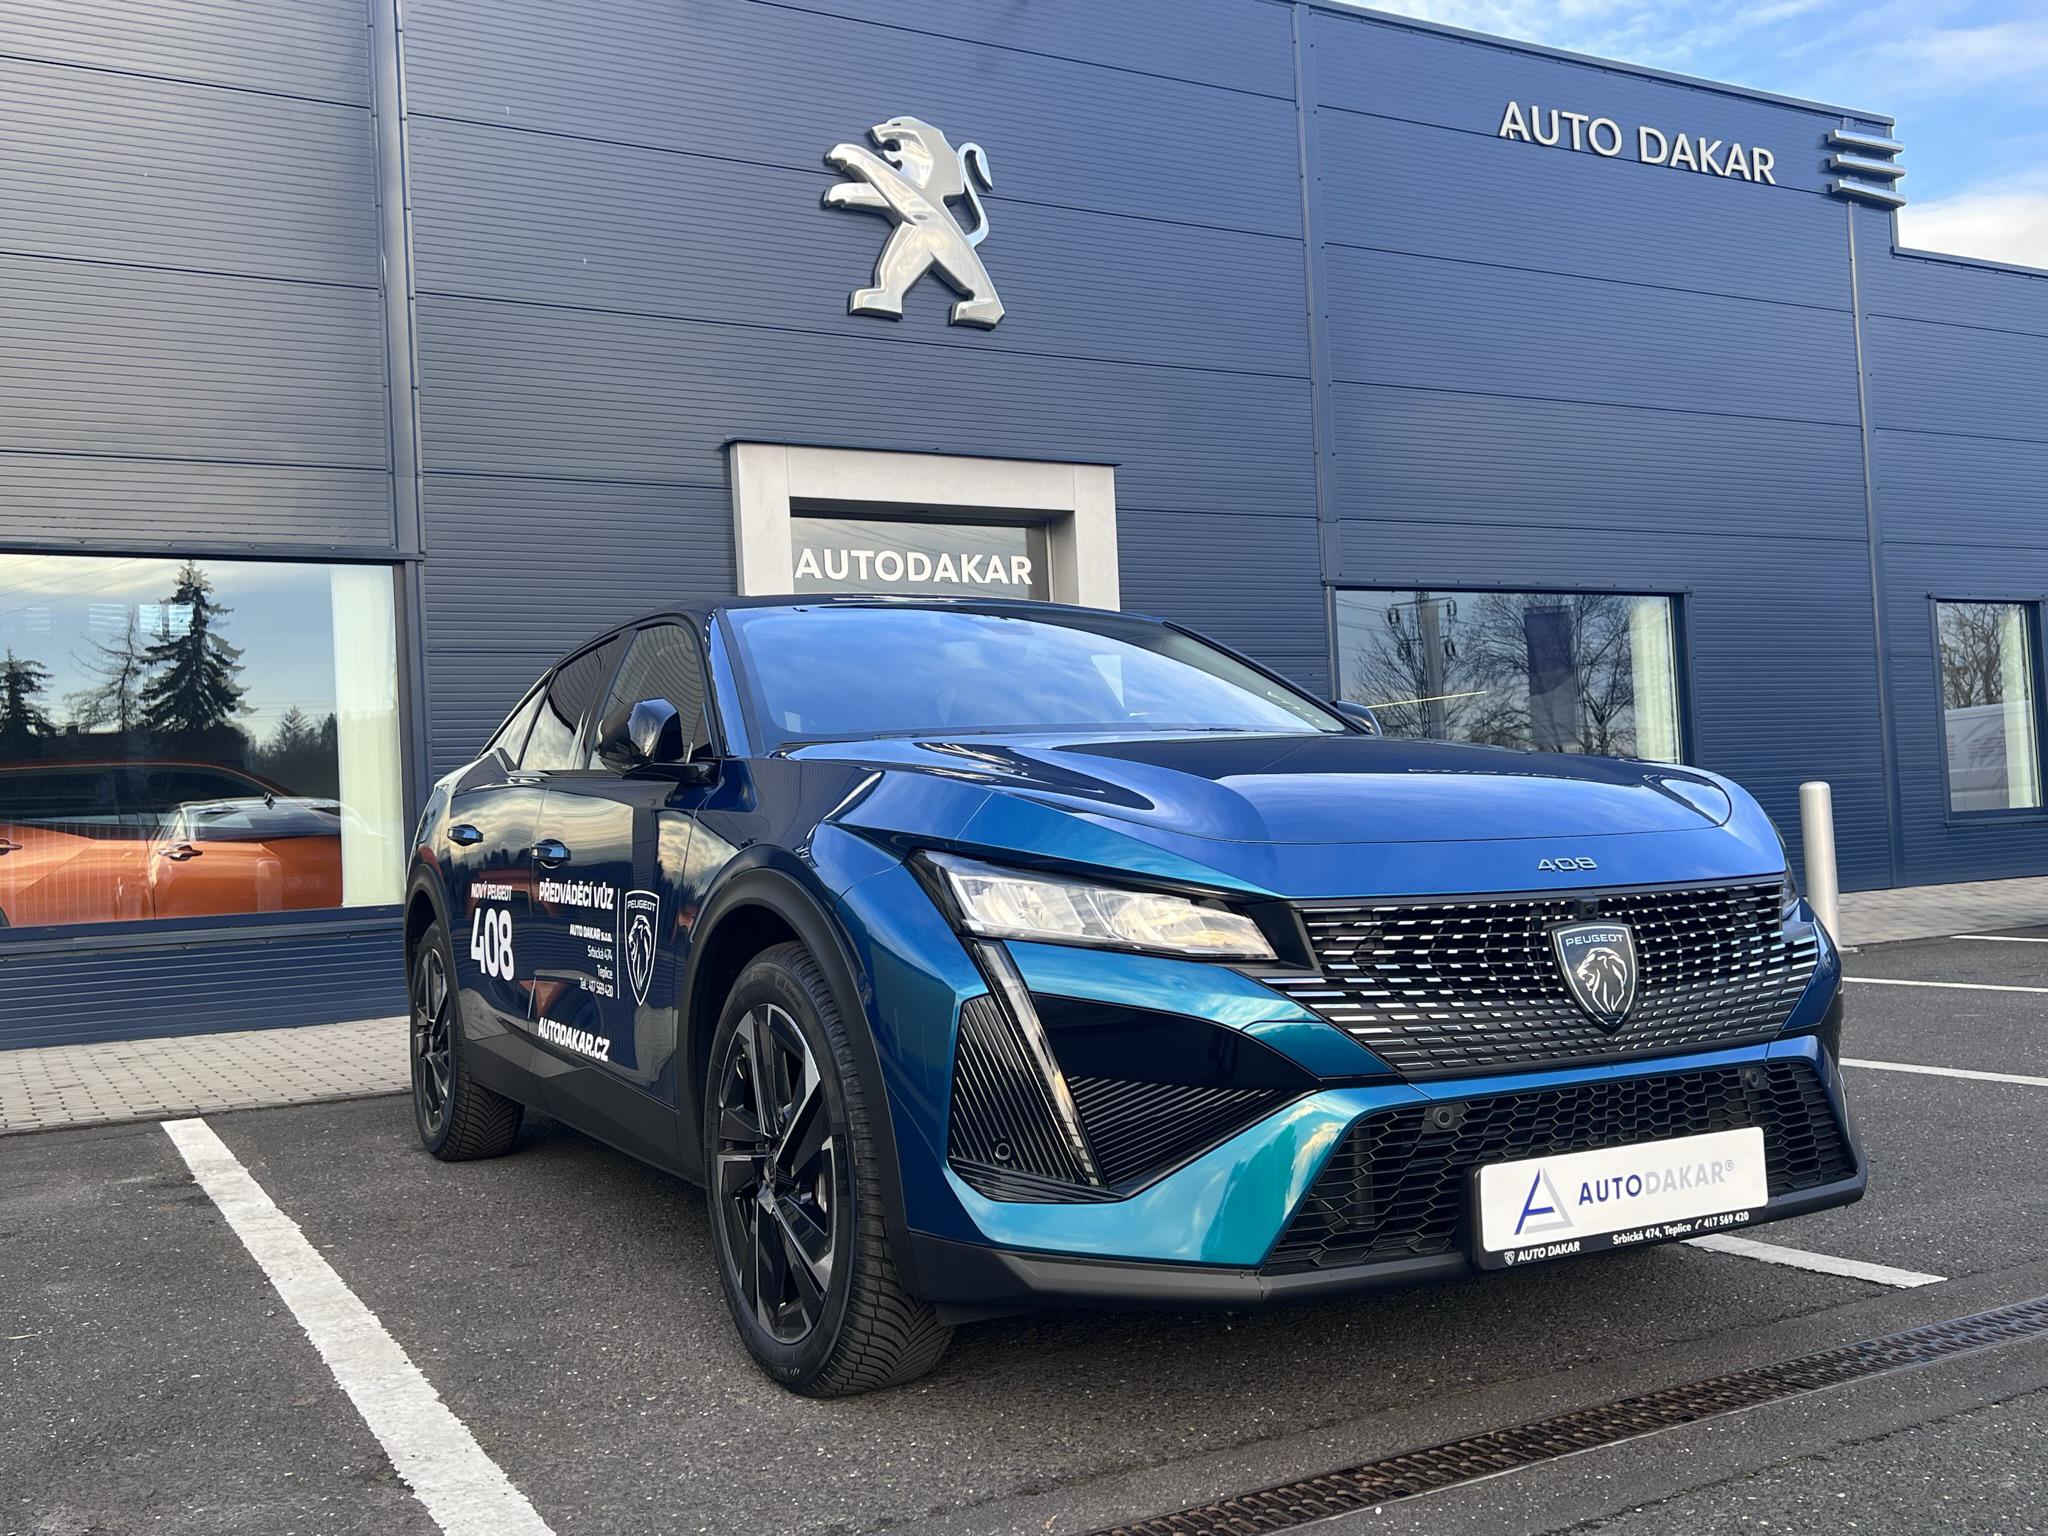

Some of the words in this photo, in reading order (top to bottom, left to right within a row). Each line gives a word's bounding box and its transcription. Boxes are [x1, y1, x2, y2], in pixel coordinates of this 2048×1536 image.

[1499, 101, 1623, 156] AUTO
[1639, 126, 1776, 185] DAKAR
[794, 548, 1033, 585] AUTODAKAR
[1537, 857, 1598, 872] 408
[487, 884, 513, 901] PEUGEOT
[539, 878, 593, 907] PŘEDVÁDĚCÍ
[593, 881, 614, 910] VŮZ
[627, 899, 656, 912] PEUGEOT
[471, 908, 515, 981] 408
[569, 923, 583, 937] AUTO
[583, 926, 601, 940] DAKAR
[1565, 934, 1624, 947] PEUGEOT
[538, 1016, 611, 1062] AUTODAKAR.CZ
[1612, 1230, 1644, 1245] Srbická
[1645, 1227, 1663, 1239] 474,
[1663, 1222, 1692, 1237] Teplice
[1703, 1216, 1718, 1228] 417
[1719, 1214, 1734, 1226] 569
[1734, 1211, 1750, 1222] 420
[1517, 1247, 1546, 1262] AUTO
[1547, 1241, 1580, 1257] DAKAR
